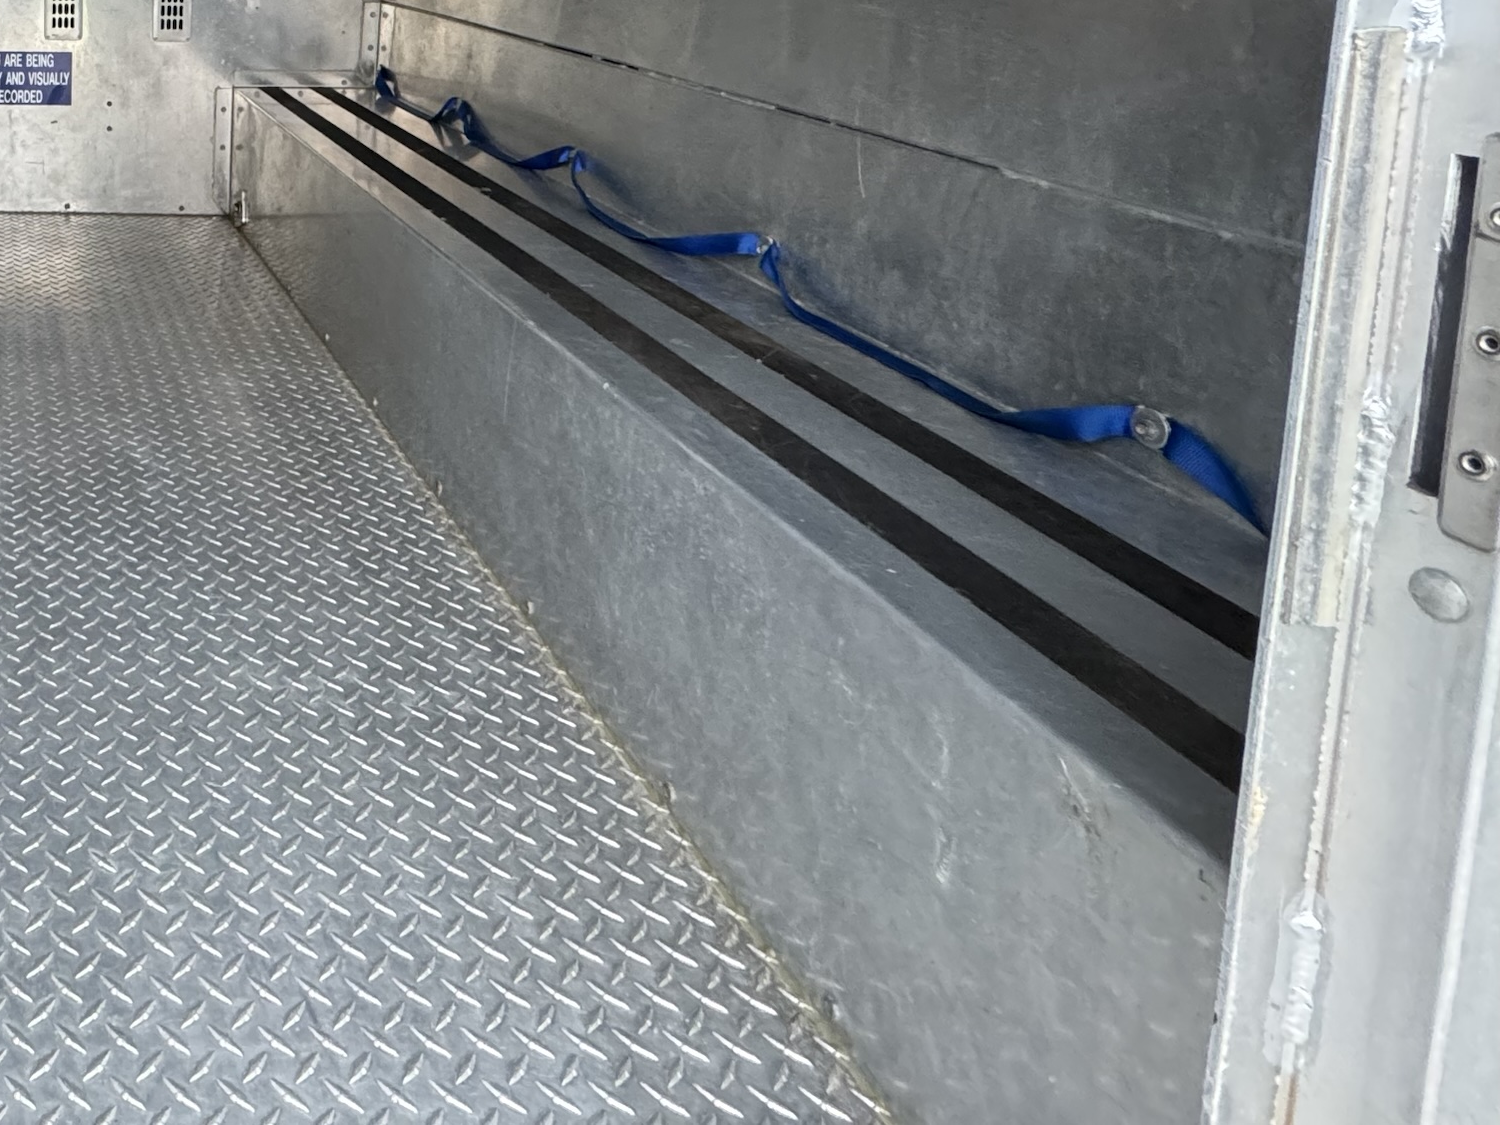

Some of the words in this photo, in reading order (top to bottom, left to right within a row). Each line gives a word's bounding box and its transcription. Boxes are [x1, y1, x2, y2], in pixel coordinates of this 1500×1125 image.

[4, 54, 22, 67] ARE
[26, 54, 54, 67] BEING
[6, 72, 25, 85] AND
[29, 72, 70, 85] VISUALLY
